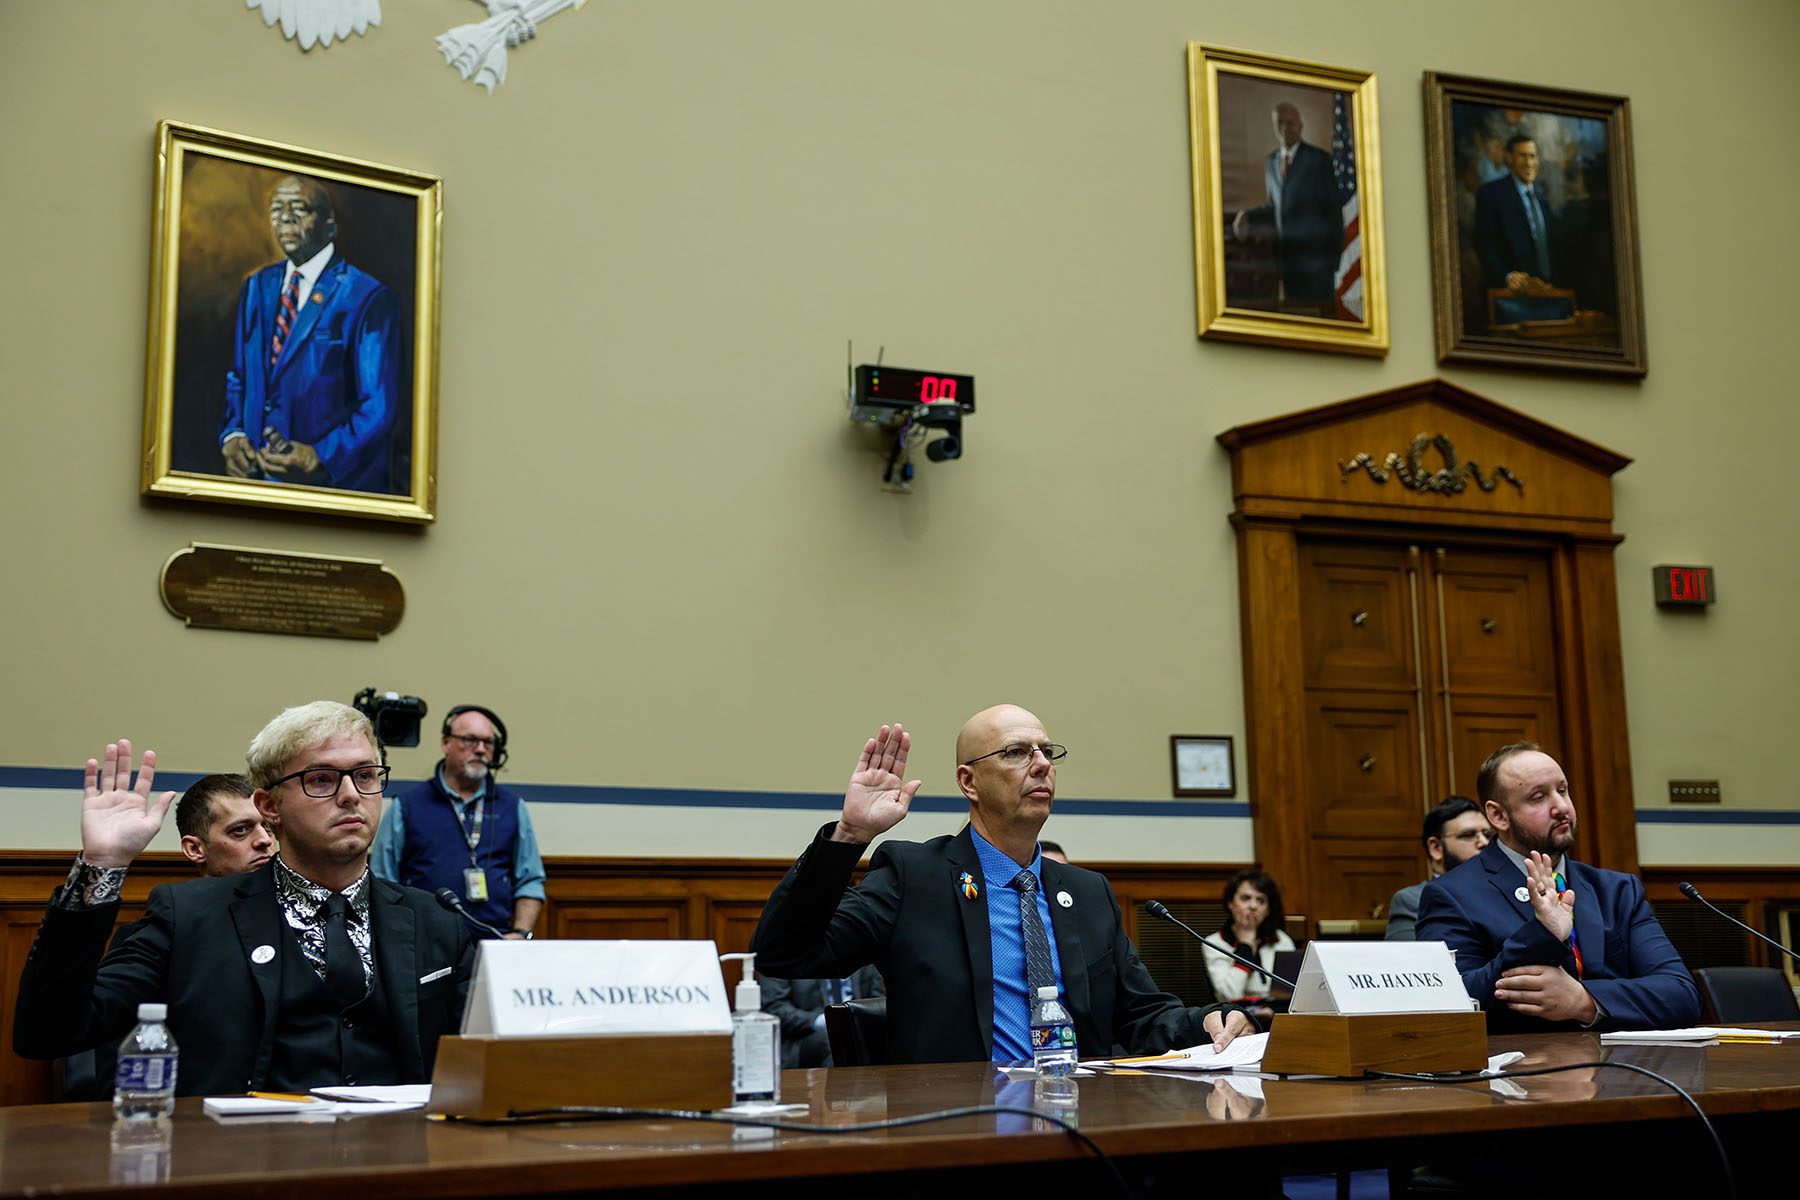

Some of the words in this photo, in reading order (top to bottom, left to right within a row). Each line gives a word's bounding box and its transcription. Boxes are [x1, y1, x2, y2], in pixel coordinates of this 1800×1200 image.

[1671, 568, 1707, 601] EXIT
[1348, 974, 1380, 989] MR.
[1381, 973, 1443, 989] HAYNES
[512, 988, 562, 1006] MR.
[572, 985, 711, 1004] ANDERSON
